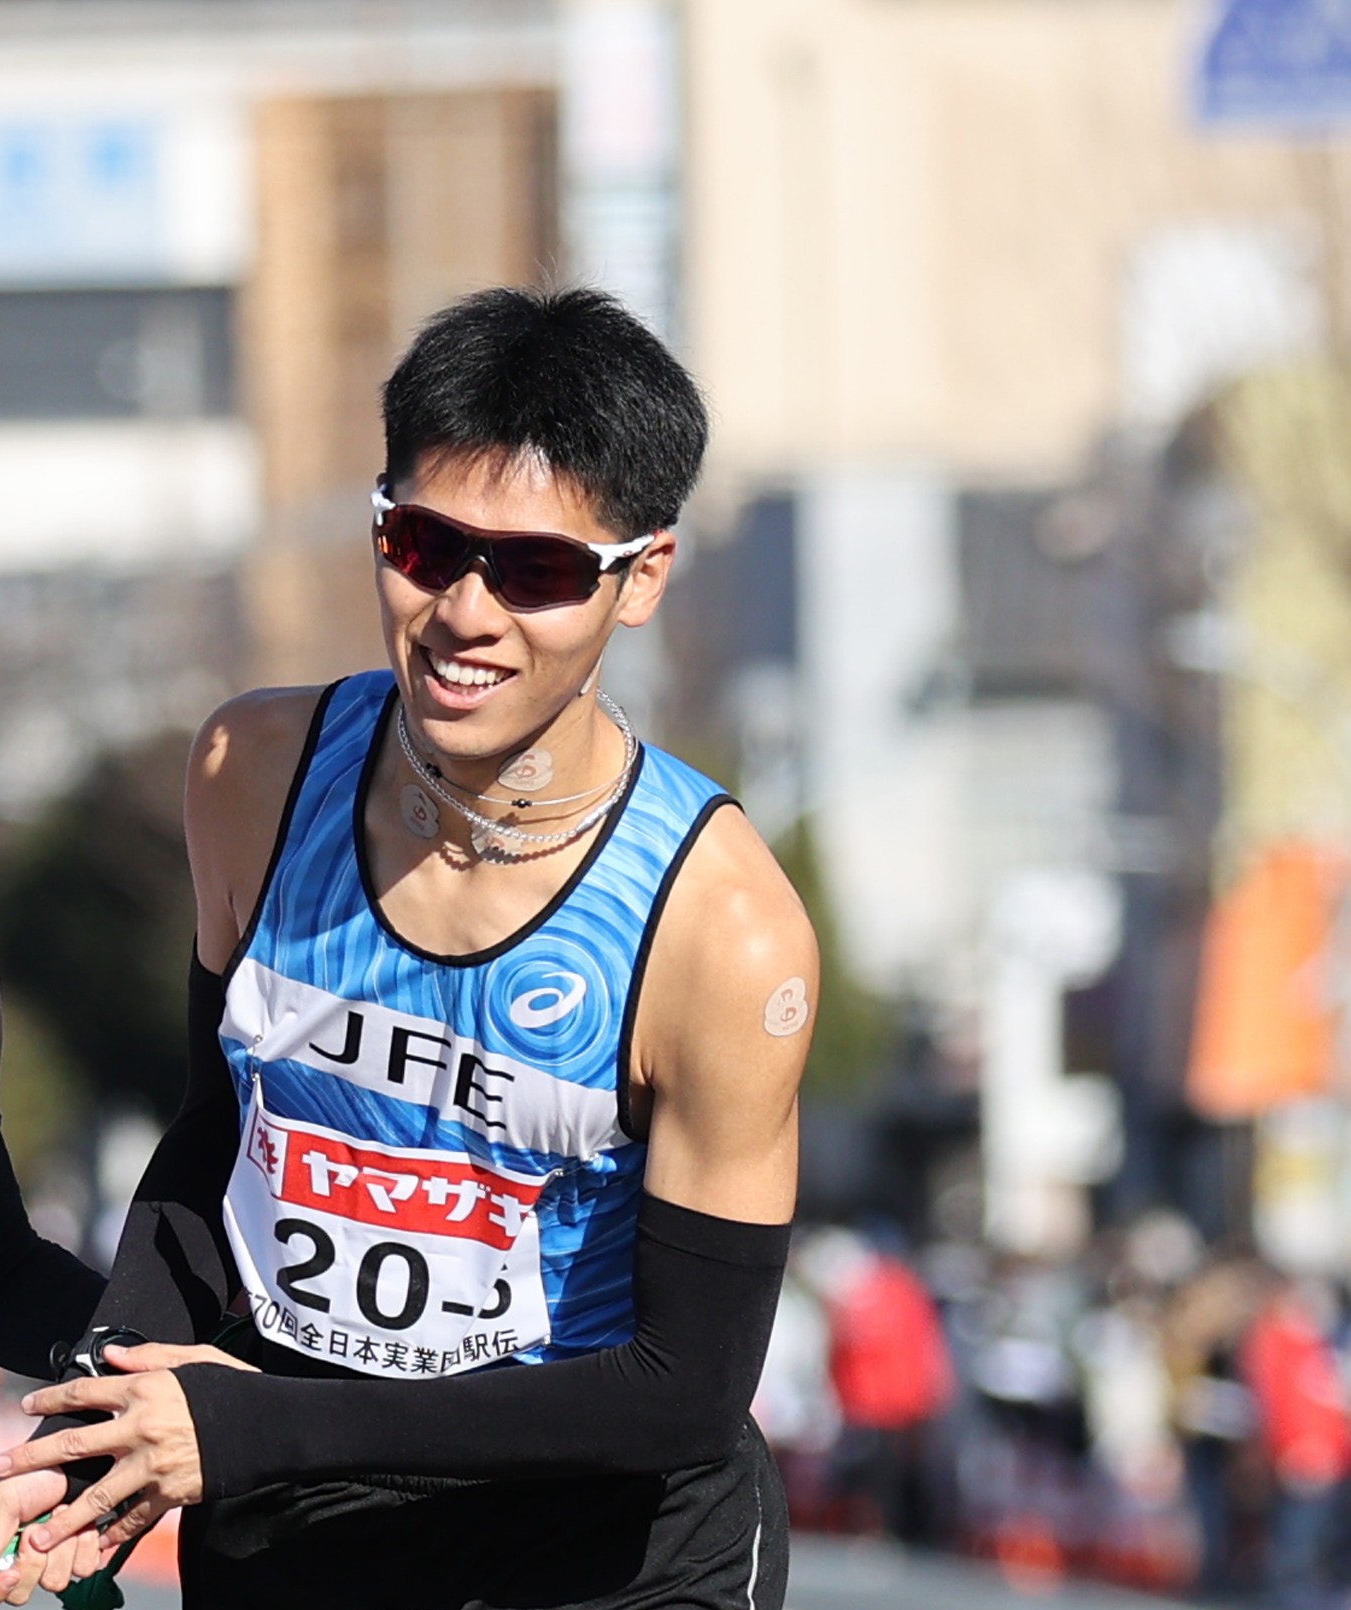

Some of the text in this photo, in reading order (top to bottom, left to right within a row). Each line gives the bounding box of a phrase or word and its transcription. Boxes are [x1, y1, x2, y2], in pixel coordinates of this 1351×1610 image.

[309, 1009, 515, 1130] JFE
[302, 1149, 536, 1238] ヤマザキ
[246, 1287, 520, 1375] 70回全日本実業団駅伝
